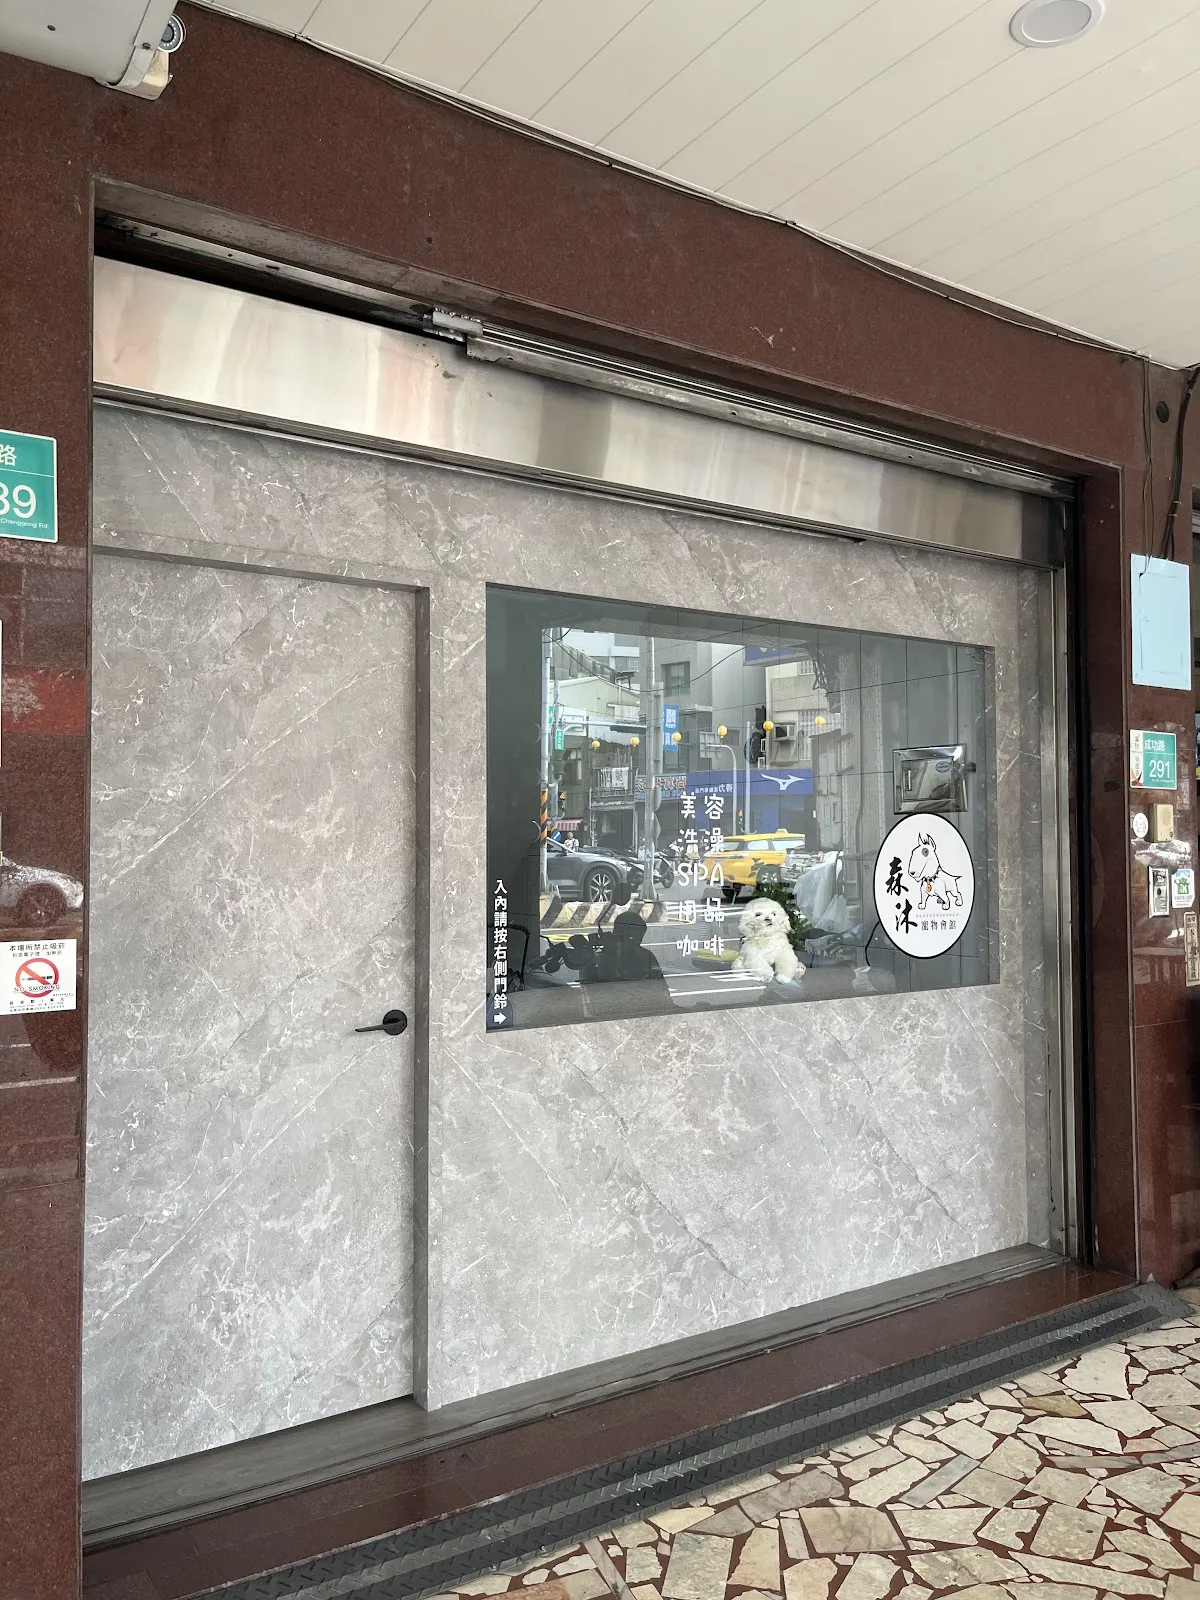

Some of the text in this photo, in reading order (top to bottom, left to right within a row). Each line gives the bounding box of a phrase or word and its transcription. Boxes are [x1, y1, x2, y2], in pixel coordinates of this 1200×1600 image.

[1144, 739, 1165, 752] 成功路
[1149, 759, 1171, 779] 291
[680, 791, 724, 820] 美容
[678, 827, 724, 852] 洗澡
[678, 862, 724, 887] SPA
[494, 879, 508, 1009] 入內請按右側門鈴
[677, 934, 724, 957] 咖啡
[28, 984, 60, 992] SMOKING
